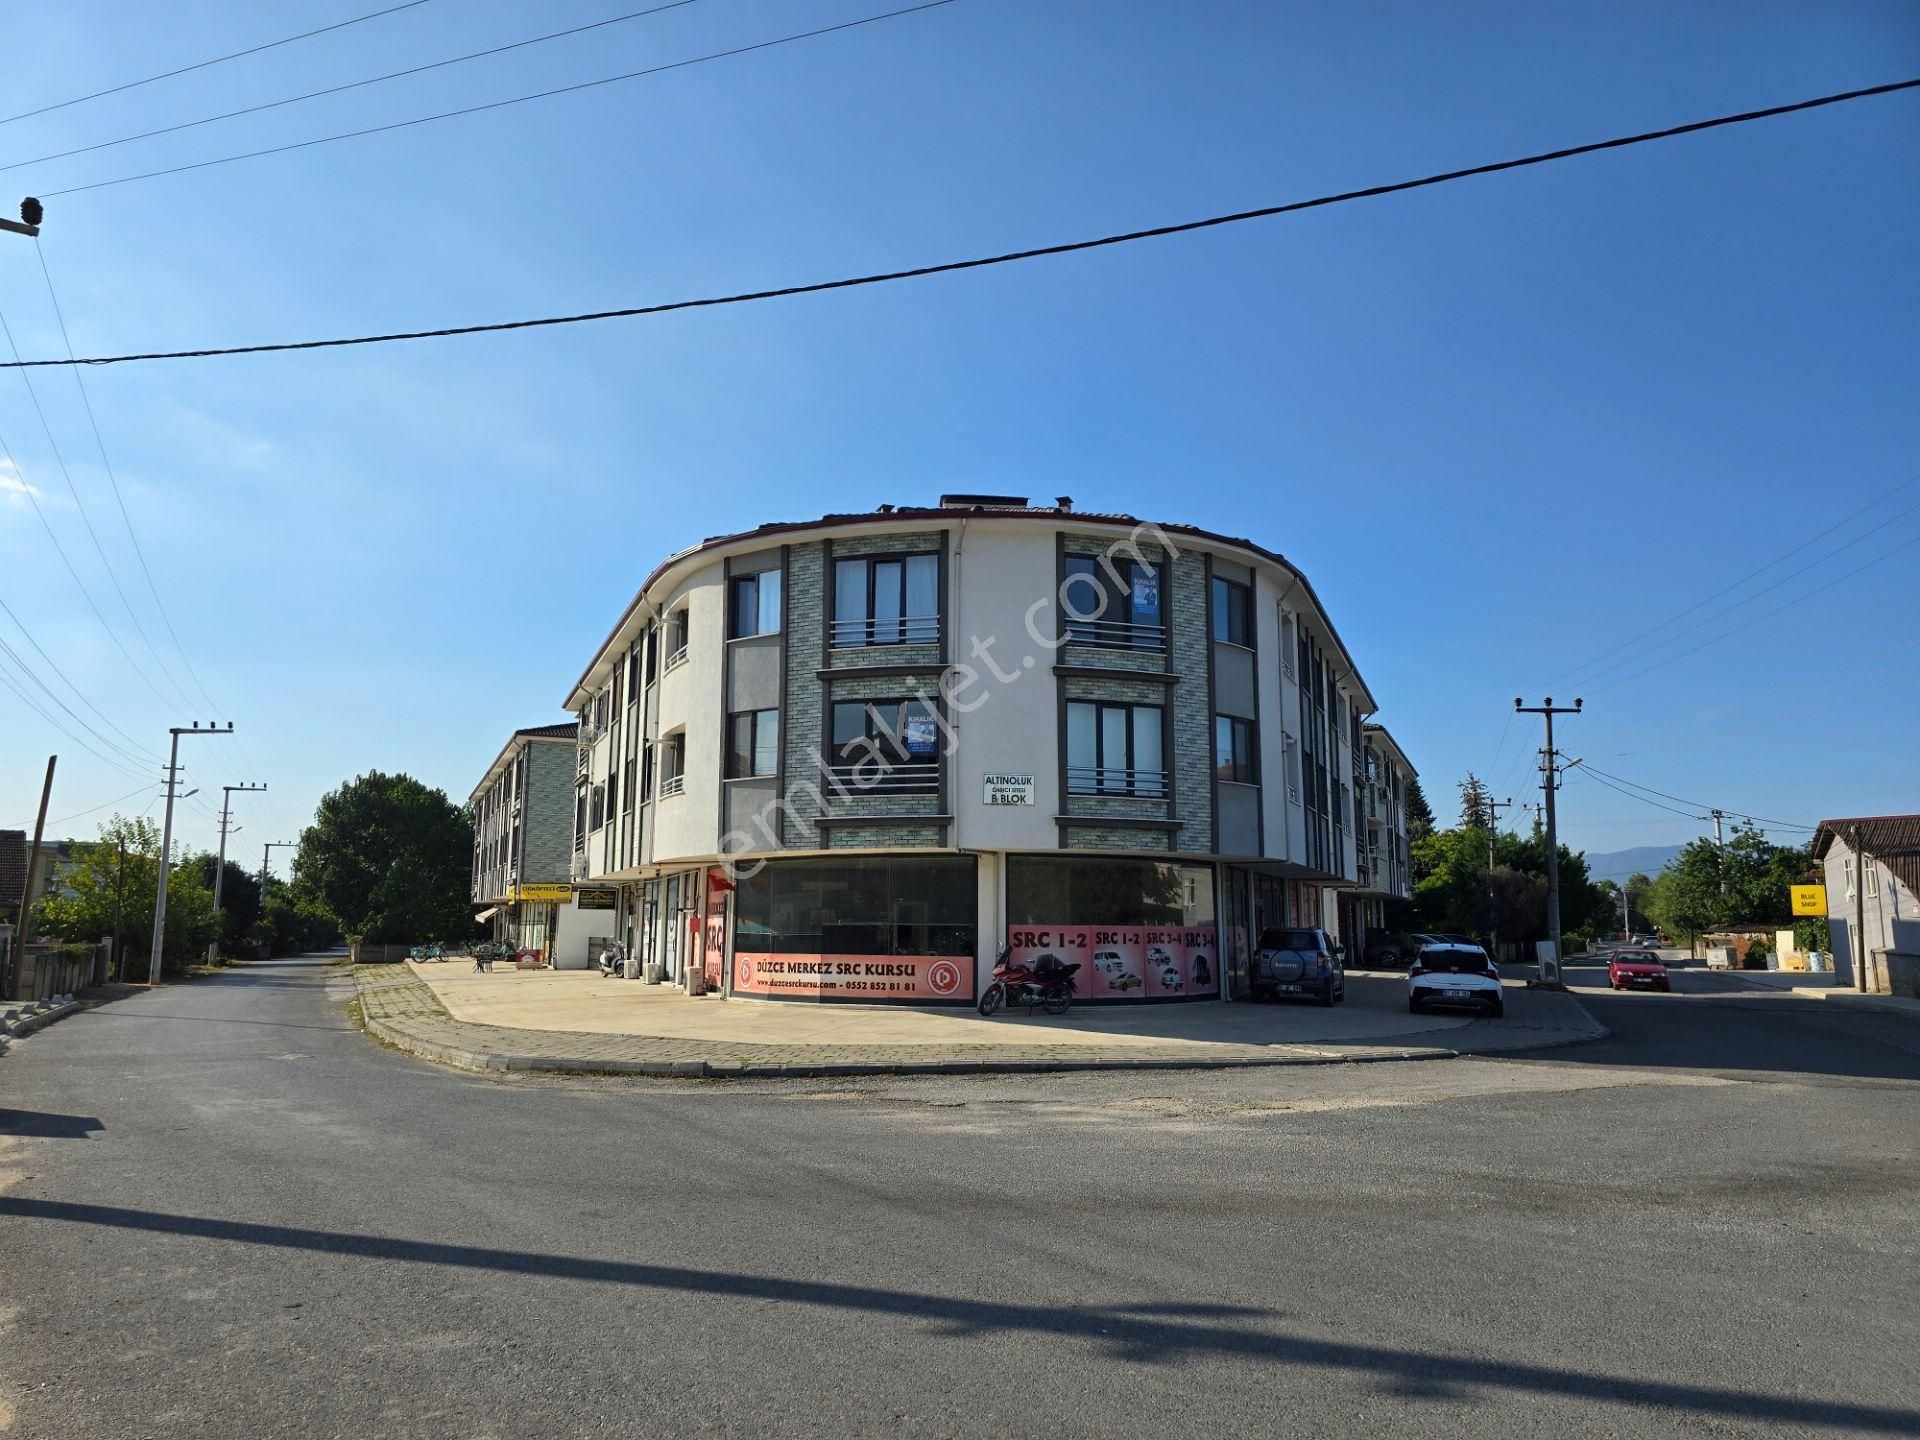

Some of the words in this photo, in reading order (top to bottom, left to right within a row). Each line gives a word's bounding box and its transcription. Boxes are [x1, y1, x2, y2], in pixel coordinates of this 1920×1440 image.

[985, 776, 1032, 785] ALTINOLUK
[991, 794, 998, 803] B
[1000, 794, 1027, 804] BLOK
[707, 924, 723, 954] SRC
[1013, 931, 1051, 948] SRC
[1059, 933, 1088, 948] 1-2
[1095, 932, 1119, 945] SRC
[1122, 933, 1140, 945] 1-2
[1146, 932, 1165, 945] SRC
[1167, 933, 1182, 945] 3-4
[1185, 932, 1201, 947] SRC
[1202, 934, 1215, 948] 3-4
[757, 958, 785, 973] DÜZCE
[787, 962, 832, 975] MERKEZ
[836, 963, 861, 976] SRC
[864, 964, 916, 976] KURSU
[757, 979, 837, 989] www.duzcesrckursu.com
[845, 982, 868, 990] 0552
[870, 982, 887, 991] 852
[889, 983, 900, 991] 81
[904, 983, 916, 991] 81
